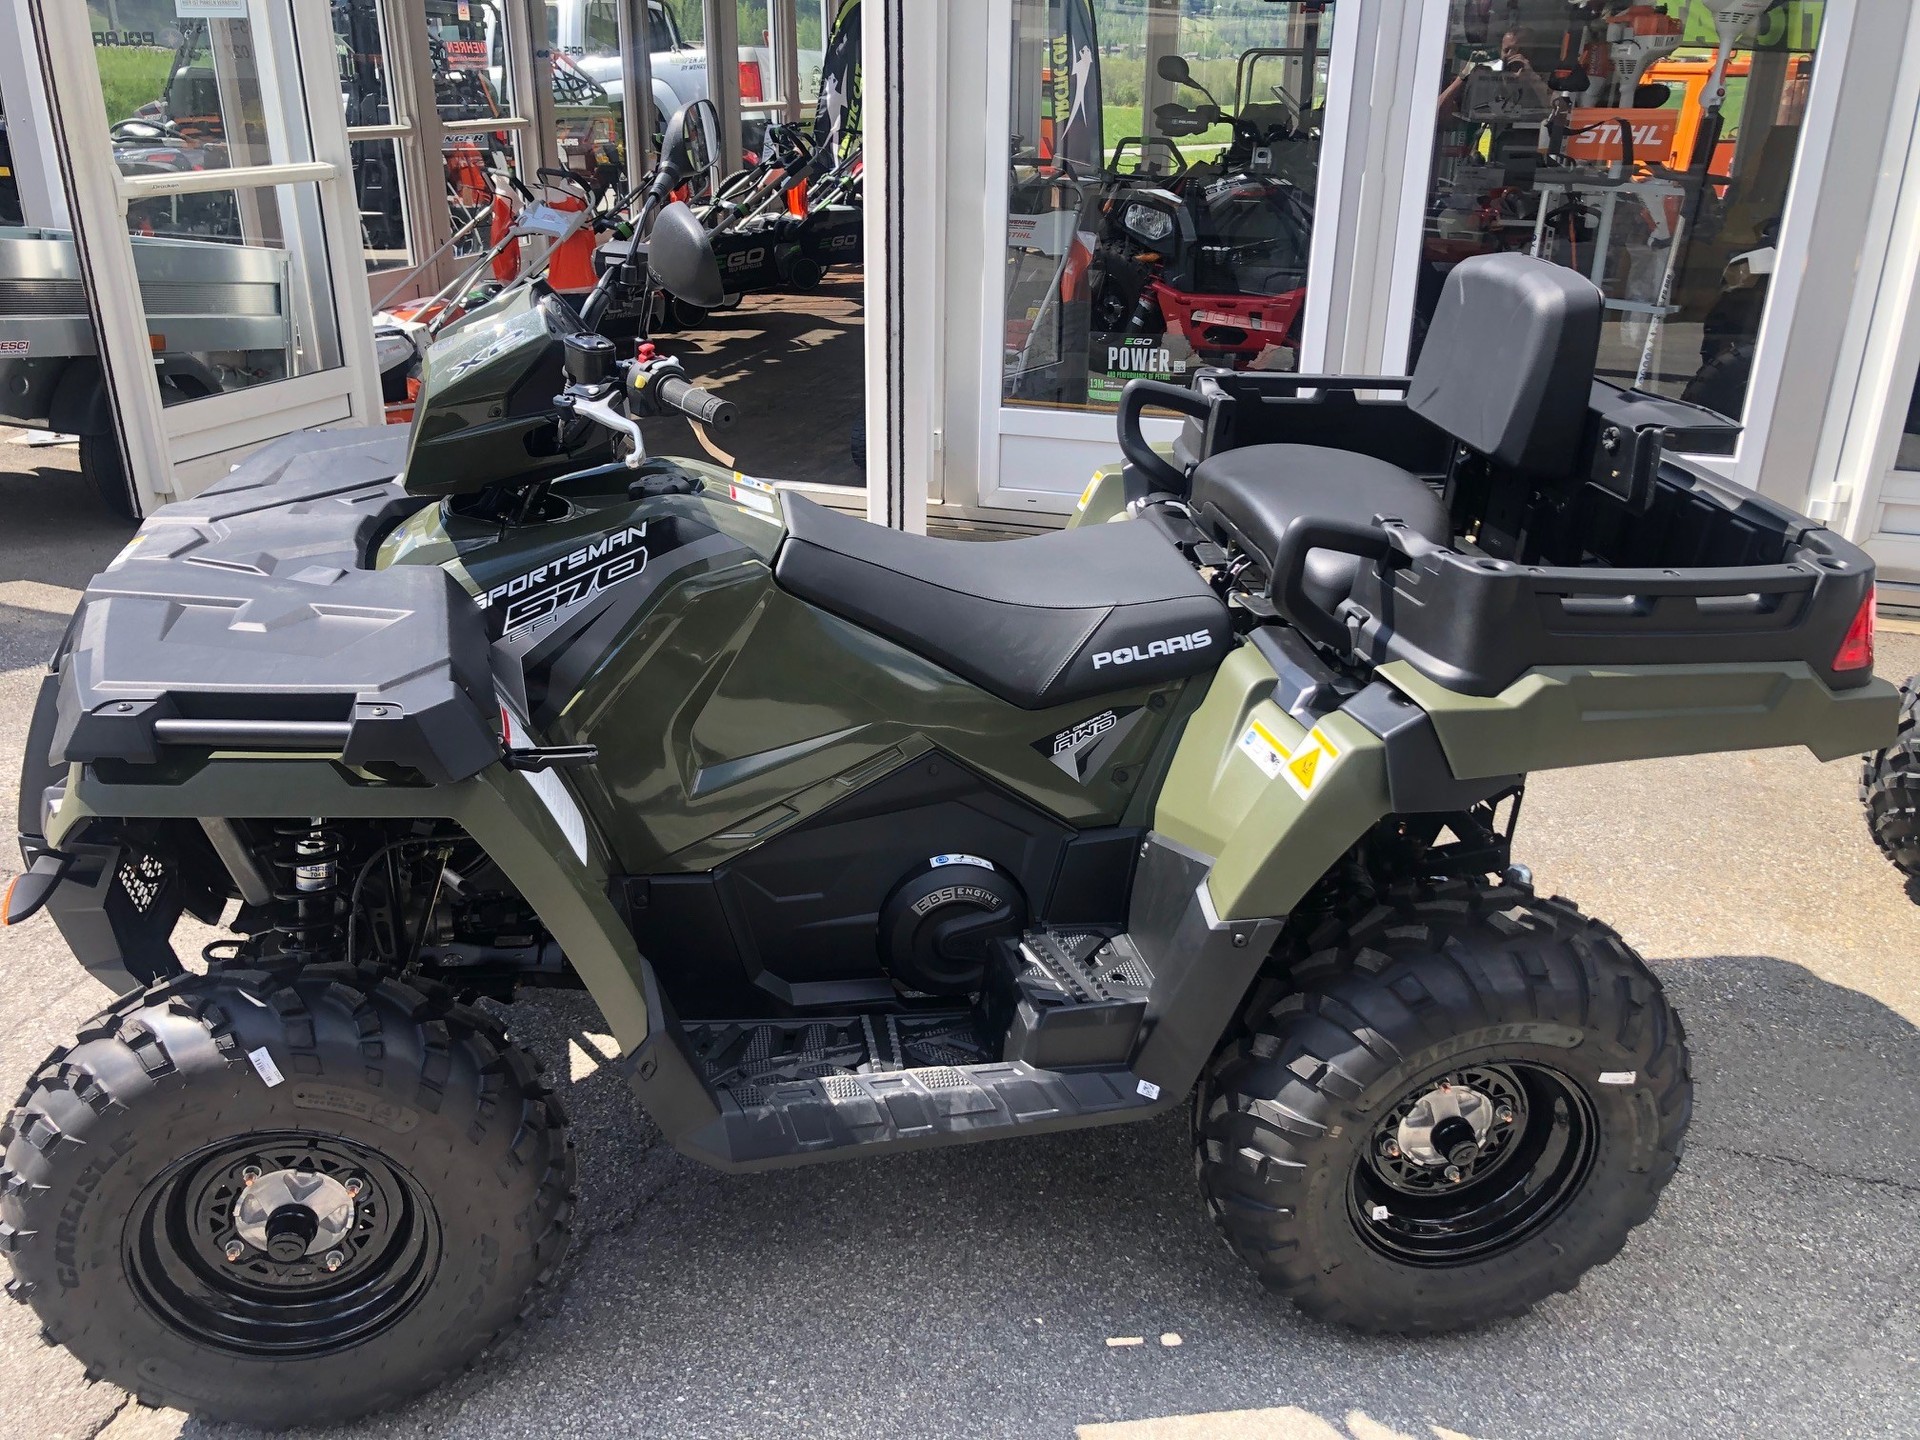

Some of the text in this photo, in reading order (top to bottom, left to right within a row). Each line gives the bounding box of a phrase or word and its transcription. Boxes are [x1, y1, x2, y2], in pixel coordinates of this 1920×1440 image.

[1107, 346, 1170, 373] POWER
[1124, 337, 1153, 346] EGO
[474, 521, 648, 610] SPORTSMAN
[502, 545, 648, 636] 570
[1092, 629, 1213, 670] POLARIS
[1053, 714, 1117, 756] AWD
[917, 888, 953, 912] EBS
[957, 888, 1000, 906] ENGINE
[55, 1130, 138, 1289] CARLISLE
